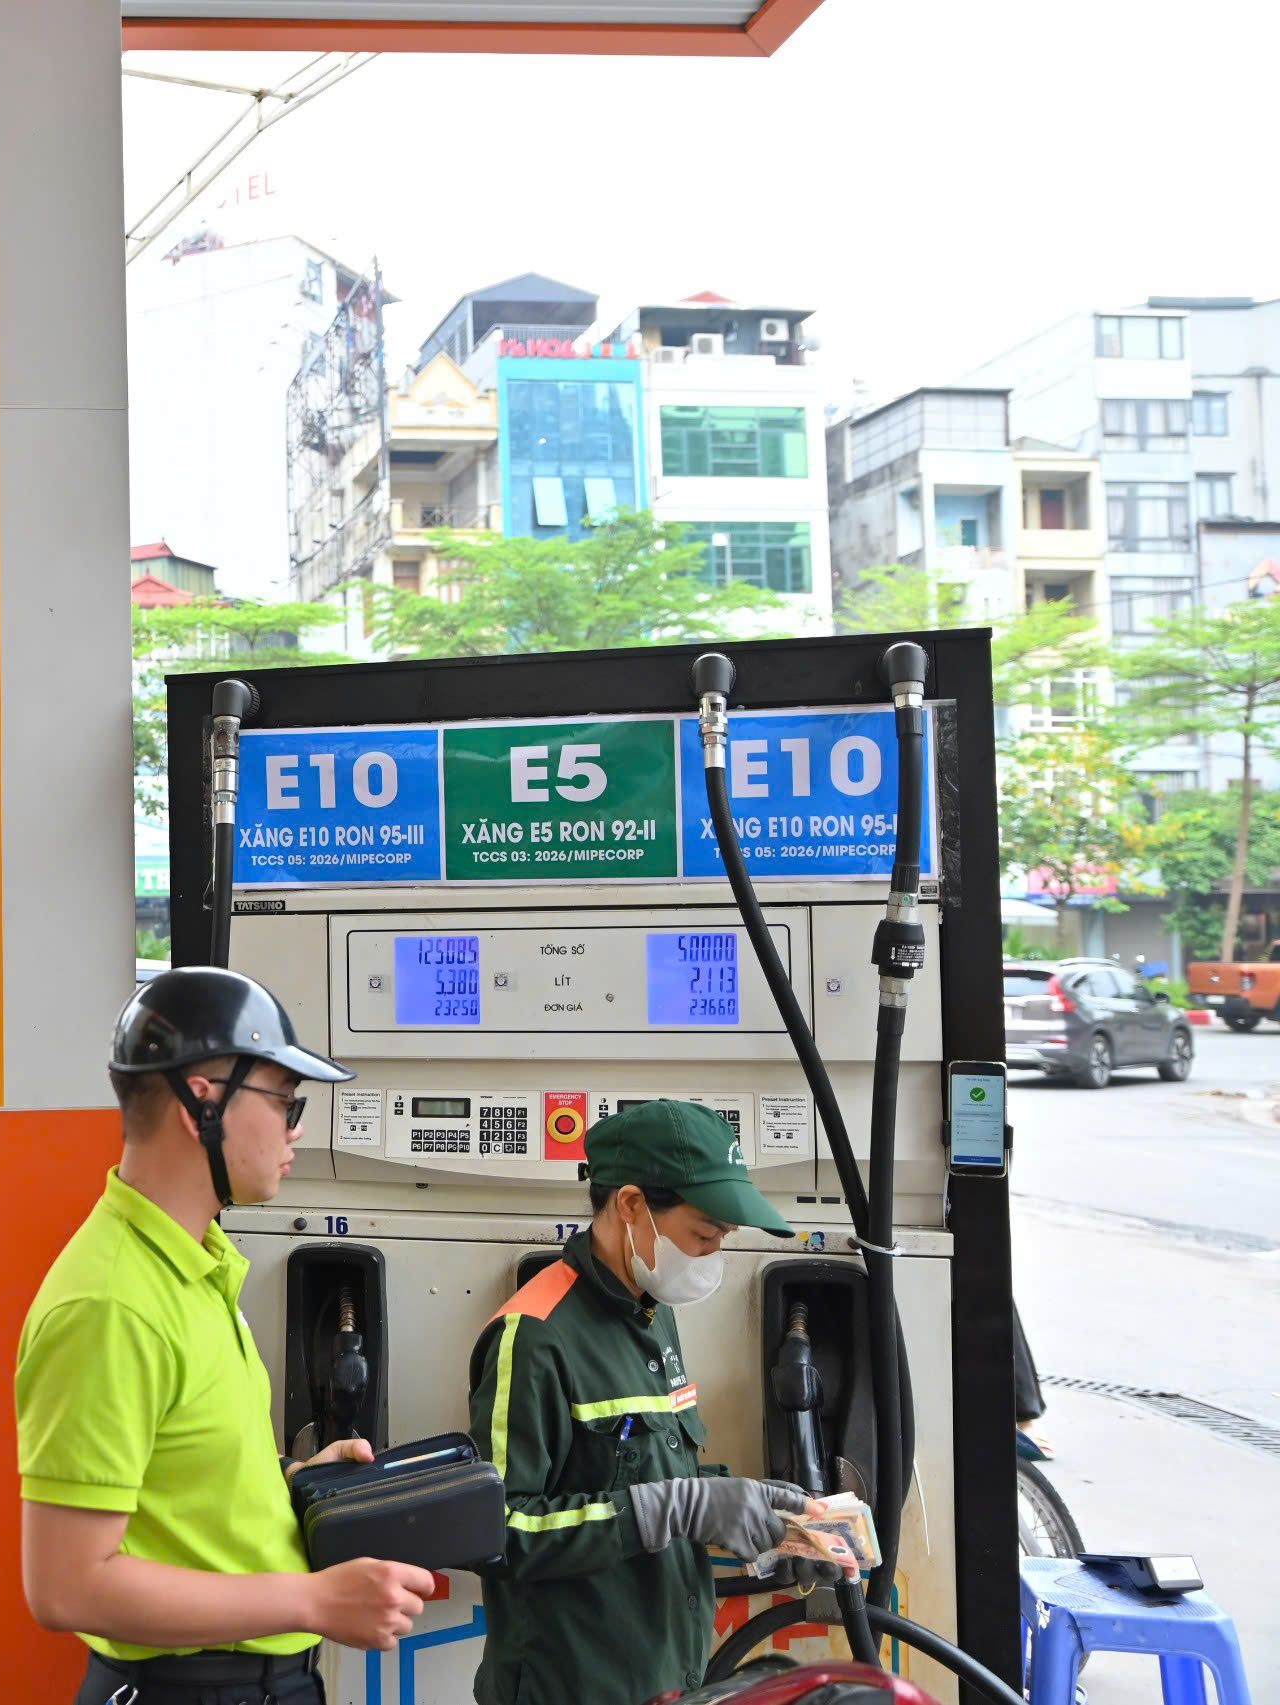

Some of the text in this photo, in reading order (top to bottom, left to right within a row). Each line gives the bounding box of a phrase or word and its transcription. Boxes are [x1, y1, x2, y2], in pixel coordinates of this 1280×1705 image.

[510, 743, 608, 803] E5
[730, 735, 882, 798] E10
[265, 751, 398, 810] E10
[239, 823, 424, 848] XĂNG E10 RON 95-III
[461, 818, 656, 844] XĂNG E5 RON 92-II
[700, 816, 762, 839] XNG
[768, 816, 803, 838] E10
[809, 815, 855, 837] RON
[251, 853, 412, 866] TCCS 05: 2026/MIPECORP
[473, 848, 644, 863] TCCS 03: 2026/MIPECORP
[714, 844, 897, 858] TS 05: 2026/MIPECORP
[236, 901, 283, 910] TATSUNO
[540, 943, 585, 955] TỔNG SỐ
[678, 935, 735, 962] 50000
[554, 976, 571, 986] LÍT
[435, 1000, 478, 1016] 23250
[544, 1002, 583, 1012] ĐƠN GIÁ
[690, 999, 736, 1016] 23660
[493, 1144, 501, 1152] C
[324, 1216, 348, 1235] 16
[555, 1223, 579, 1240] 17
